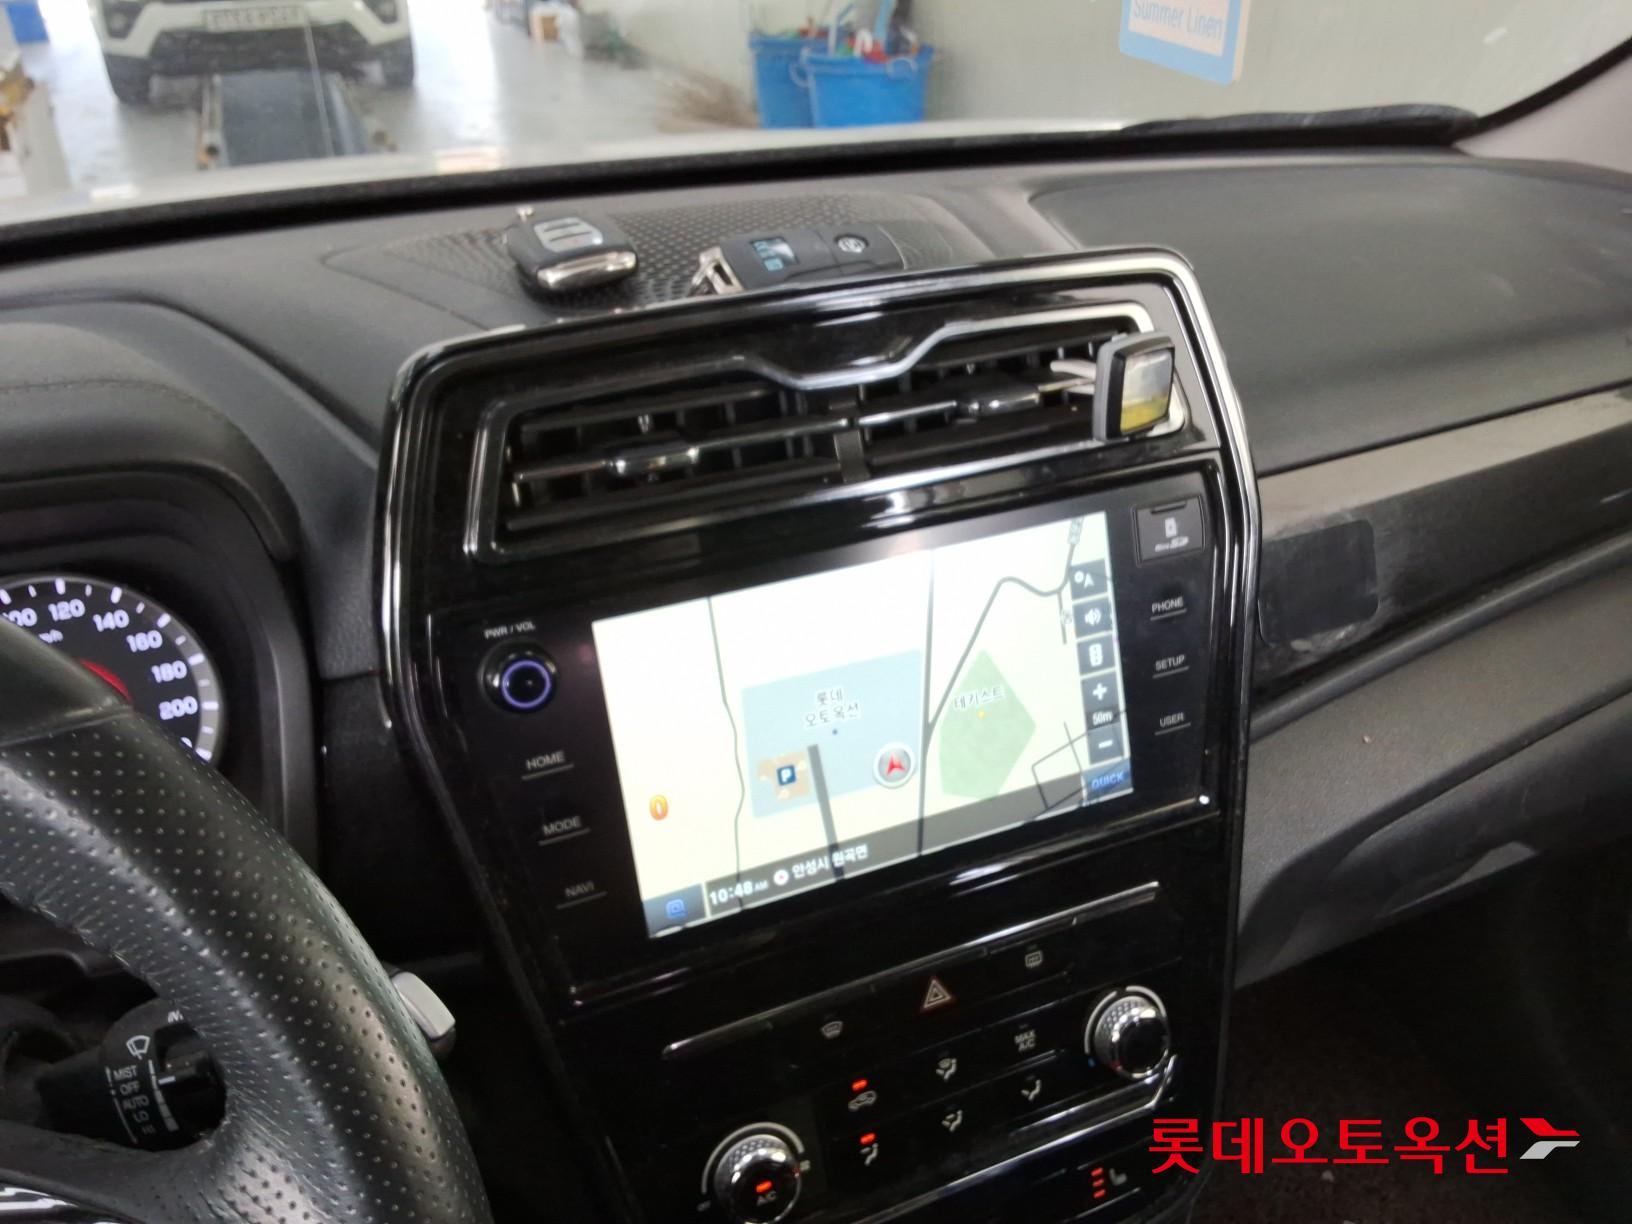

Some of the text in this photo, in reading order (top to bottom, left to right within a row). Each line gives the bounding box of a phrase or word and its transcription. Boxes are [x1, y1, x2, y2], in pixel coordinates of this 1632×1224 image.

[48, 599, 86, 621] 120
[1151, 596, 1184, 613] PHONE
[93, 609, 130, 632] 140
[484, 628, 508, 640] PWR
[515, 621, 536, 633] VOL
[126, 630, 163, 653] 160
[151, 660, 188, 683] 180
[1155, 654, 1186, 671] SETUP
[817, 688, 843, 706] 롯데
[159, 696, 198, 720] 200
[1160, 712, 1185, 727] USER
[525, 751, 566, 771] HOME
[1091, 771, 1126, 790] QUICK
[543, 815, 582, 836] MODE
[792, 855, 830, 879] 안성시
[565, 880, 595, 898] NAVI
[709, 880, 753, 906] 10:48
[113, 1065, 137, 1080] MIST
[120, 1081, 140, 1096] OFF
[123, 1094, 150, 1111] AUTO
